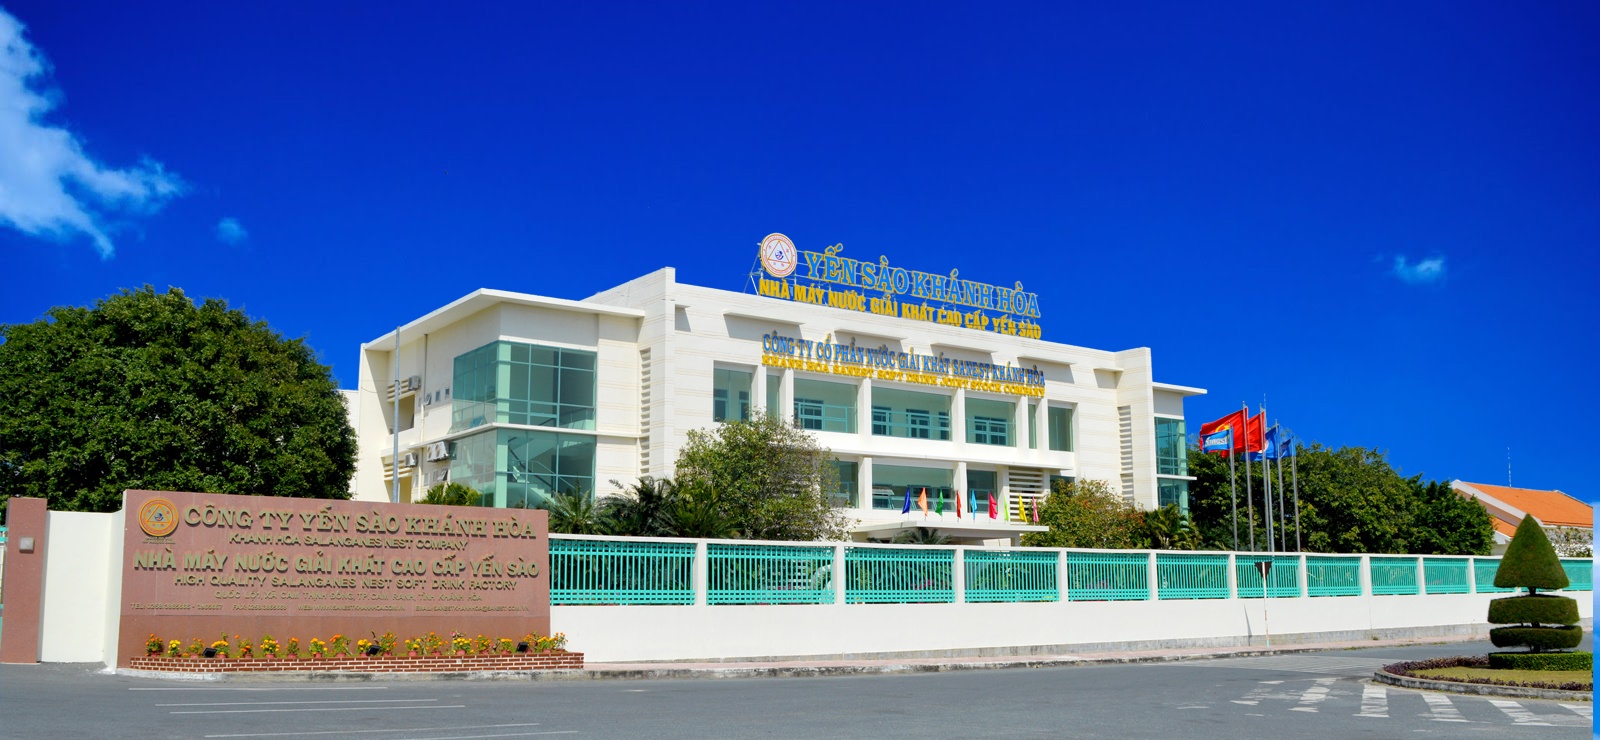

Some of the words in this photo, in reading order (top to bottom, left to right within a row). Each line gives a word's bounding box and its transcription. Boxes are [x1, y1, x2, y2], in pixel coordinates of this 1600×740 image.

[804, 243, 858, 285] YẾN
[862, 255, 908, 295] SÀO
[911, 268, 994, 310] KHÁNH
[996, 281, 1041, 318] HÒA
[760, 278, 790, 299] NHÀ
[794, 283, 824, 305] MÁY
[828, 290, 866, 311] NƯỚC
[870, 294, 898, 317] GIẢI
[901, 302, 935, 322] KHÁT
[937, 308, 962, 327] CAO
[964, 309, 990, 331] CẤP
[992, 314, 1016, 336] YẾN
[1018, 319, 1042, 340] SÀO
[762, 330, 795, 355] CÔNG
[798, 338, 814, 357] TY
[816, 333, 832, 360] CỔ
[834, 336, 864, 364] PHẦN
[866, 344, 896, 368] NƯỚC
[898, 347, 920, 370] GIẢI
[922, 352, 950, 374] KHÁT
[953, 359, 990, 379] SANEST
[992, 361, 1025, 383] KHÁNH
[1026, 364, 1046, 386] HÒA
[762, 355, 804, 371] KHANH
[806, 361, 829, 373] HOA
[833, 364, 874, 378] SANEST
[877, 369, 904, 382] SOFT
[906, 372, 938, 385] DRINK
[940, 376, 968, 389] JOINT
[970, 381, 1002, 393] STOCK
[1003, 384, 1045, 398] COMPANY
[184, 503, 253, 529] CÔNG
[259, 511, 294, 530] TY
[299, 505, 350, 532] YẾN
[355, 509, 400, 533] SÀO
[405, 514, 487, 538] KHÁNH
[492, 515, 536, 539] HÒA
[229, 533, 273, 544] KHANH
[276, 535, 301, 546] HOA
[304, 535, 382, 548] SALANGANES
[384, 538, 413, 549] NEST
[416, 539, 468, 551] COMPANY
[134, 547, 177, 571] NHÀ
[184, 549, 228, 572] MÁY
[234, 551, 289, 573] NƯỚC
[295, 550, 332, 574] GIẢI
[338, 554, 385, 575] KHÁT
[391, 558, 427, 576] CAO
[432, 554, 466, 577] CẤP
[470, 555, 503, 578] YẾN
[507, 557, 540, 578] SÀO
[174, 575, 205, 586] HIGH
[209, 575, 266, 588] QUALITY
[271, 576, 356, 589] SALANGANES
[361, 578, 392, 590] NEST
[396, 579, 426, 590] SOFT
[432, 579, 465, 591] DRINK
[469, 580, 517, 592] FACTORY
[280, 591, 299, 600] CAM
